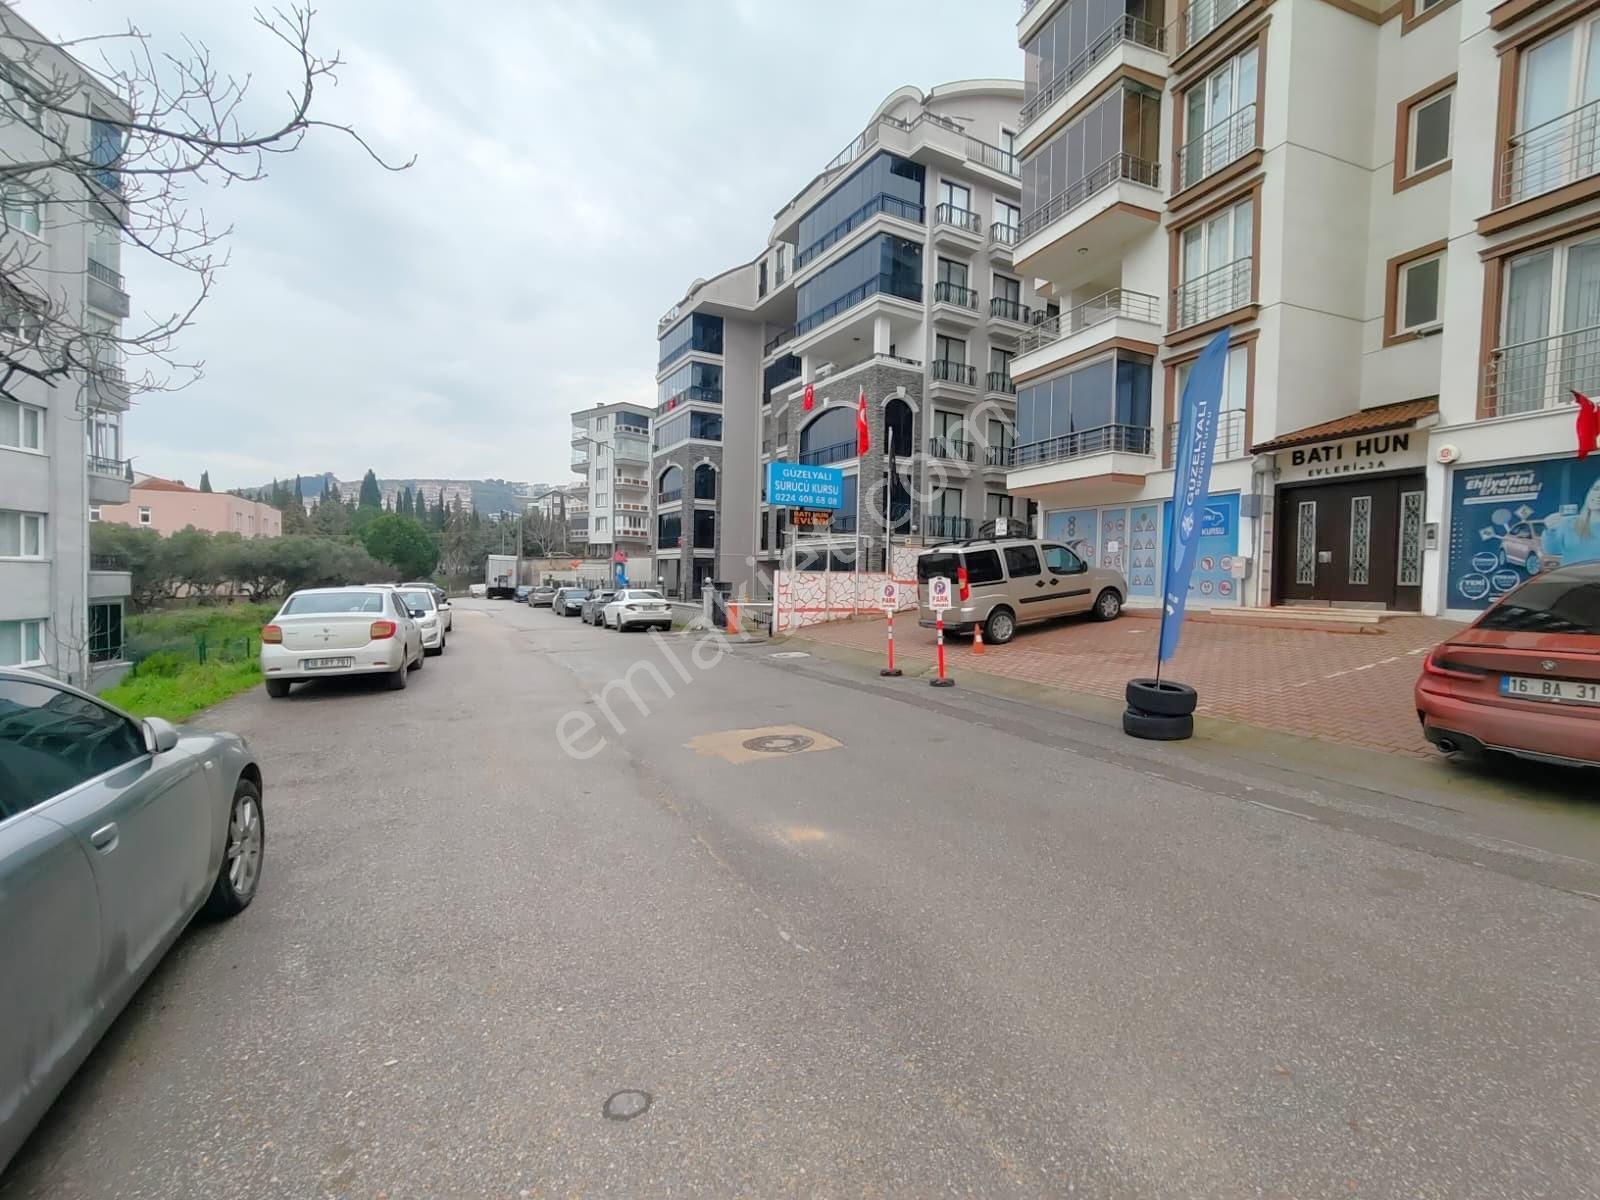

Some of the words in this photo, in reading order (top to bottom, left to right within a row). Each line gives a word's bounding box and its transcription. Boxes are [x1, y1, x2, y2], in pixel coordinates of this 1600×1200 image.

[1291, 442, 1343, 466] BATI
[1356, 434, 1409, 457] HUN
[782, 467, 832, 481] GÜZELYALI
[775, 478, 810, 493] SÜRÜCÜ
[812, 483, 839, 496] KURSU
[775, 493, 796, 502] 0224
[1511, 679, 1528, 692] 16
[1542, 681, 1561, 696] BA
[1576, 685, 1596, 699] 31
